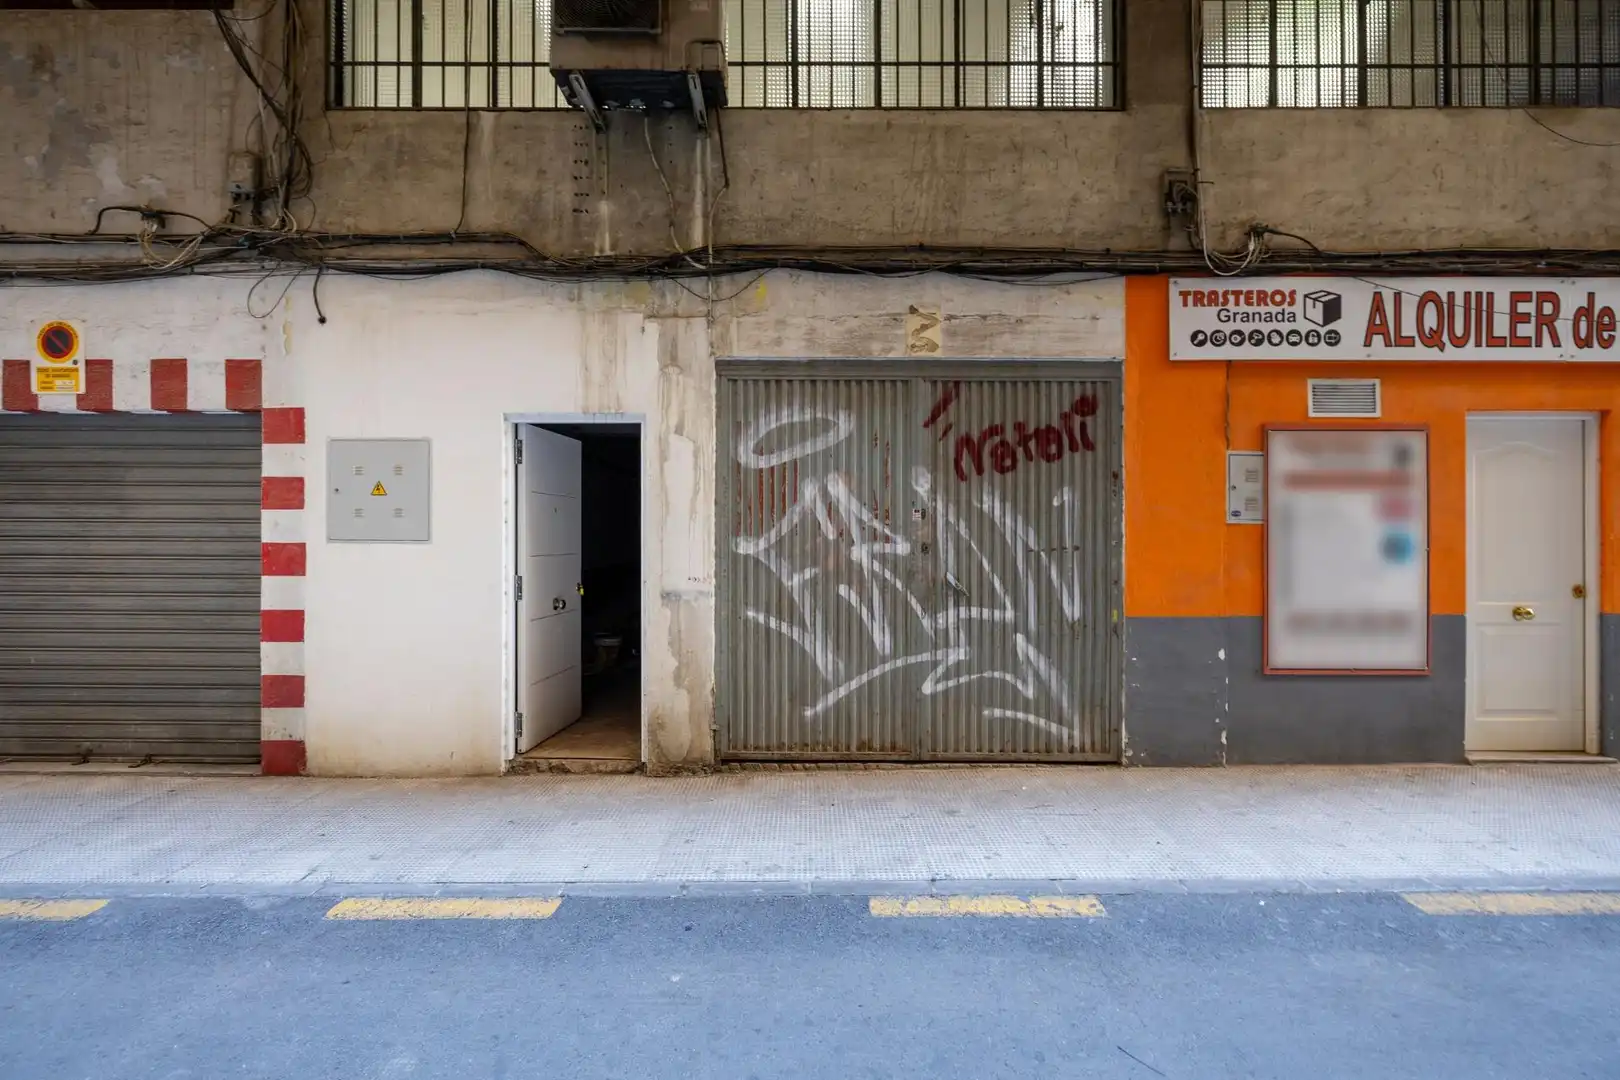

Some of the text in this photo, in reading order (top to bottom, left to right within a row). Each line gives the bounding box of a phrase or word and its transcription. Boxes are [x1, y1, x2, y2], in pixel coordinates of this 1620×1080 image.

[1178, 289, 1297, 307] TRASTEROS
[1216, 308, 1296, 323] Granada
[1363, 290, 1617, 352] ALQUILER de
